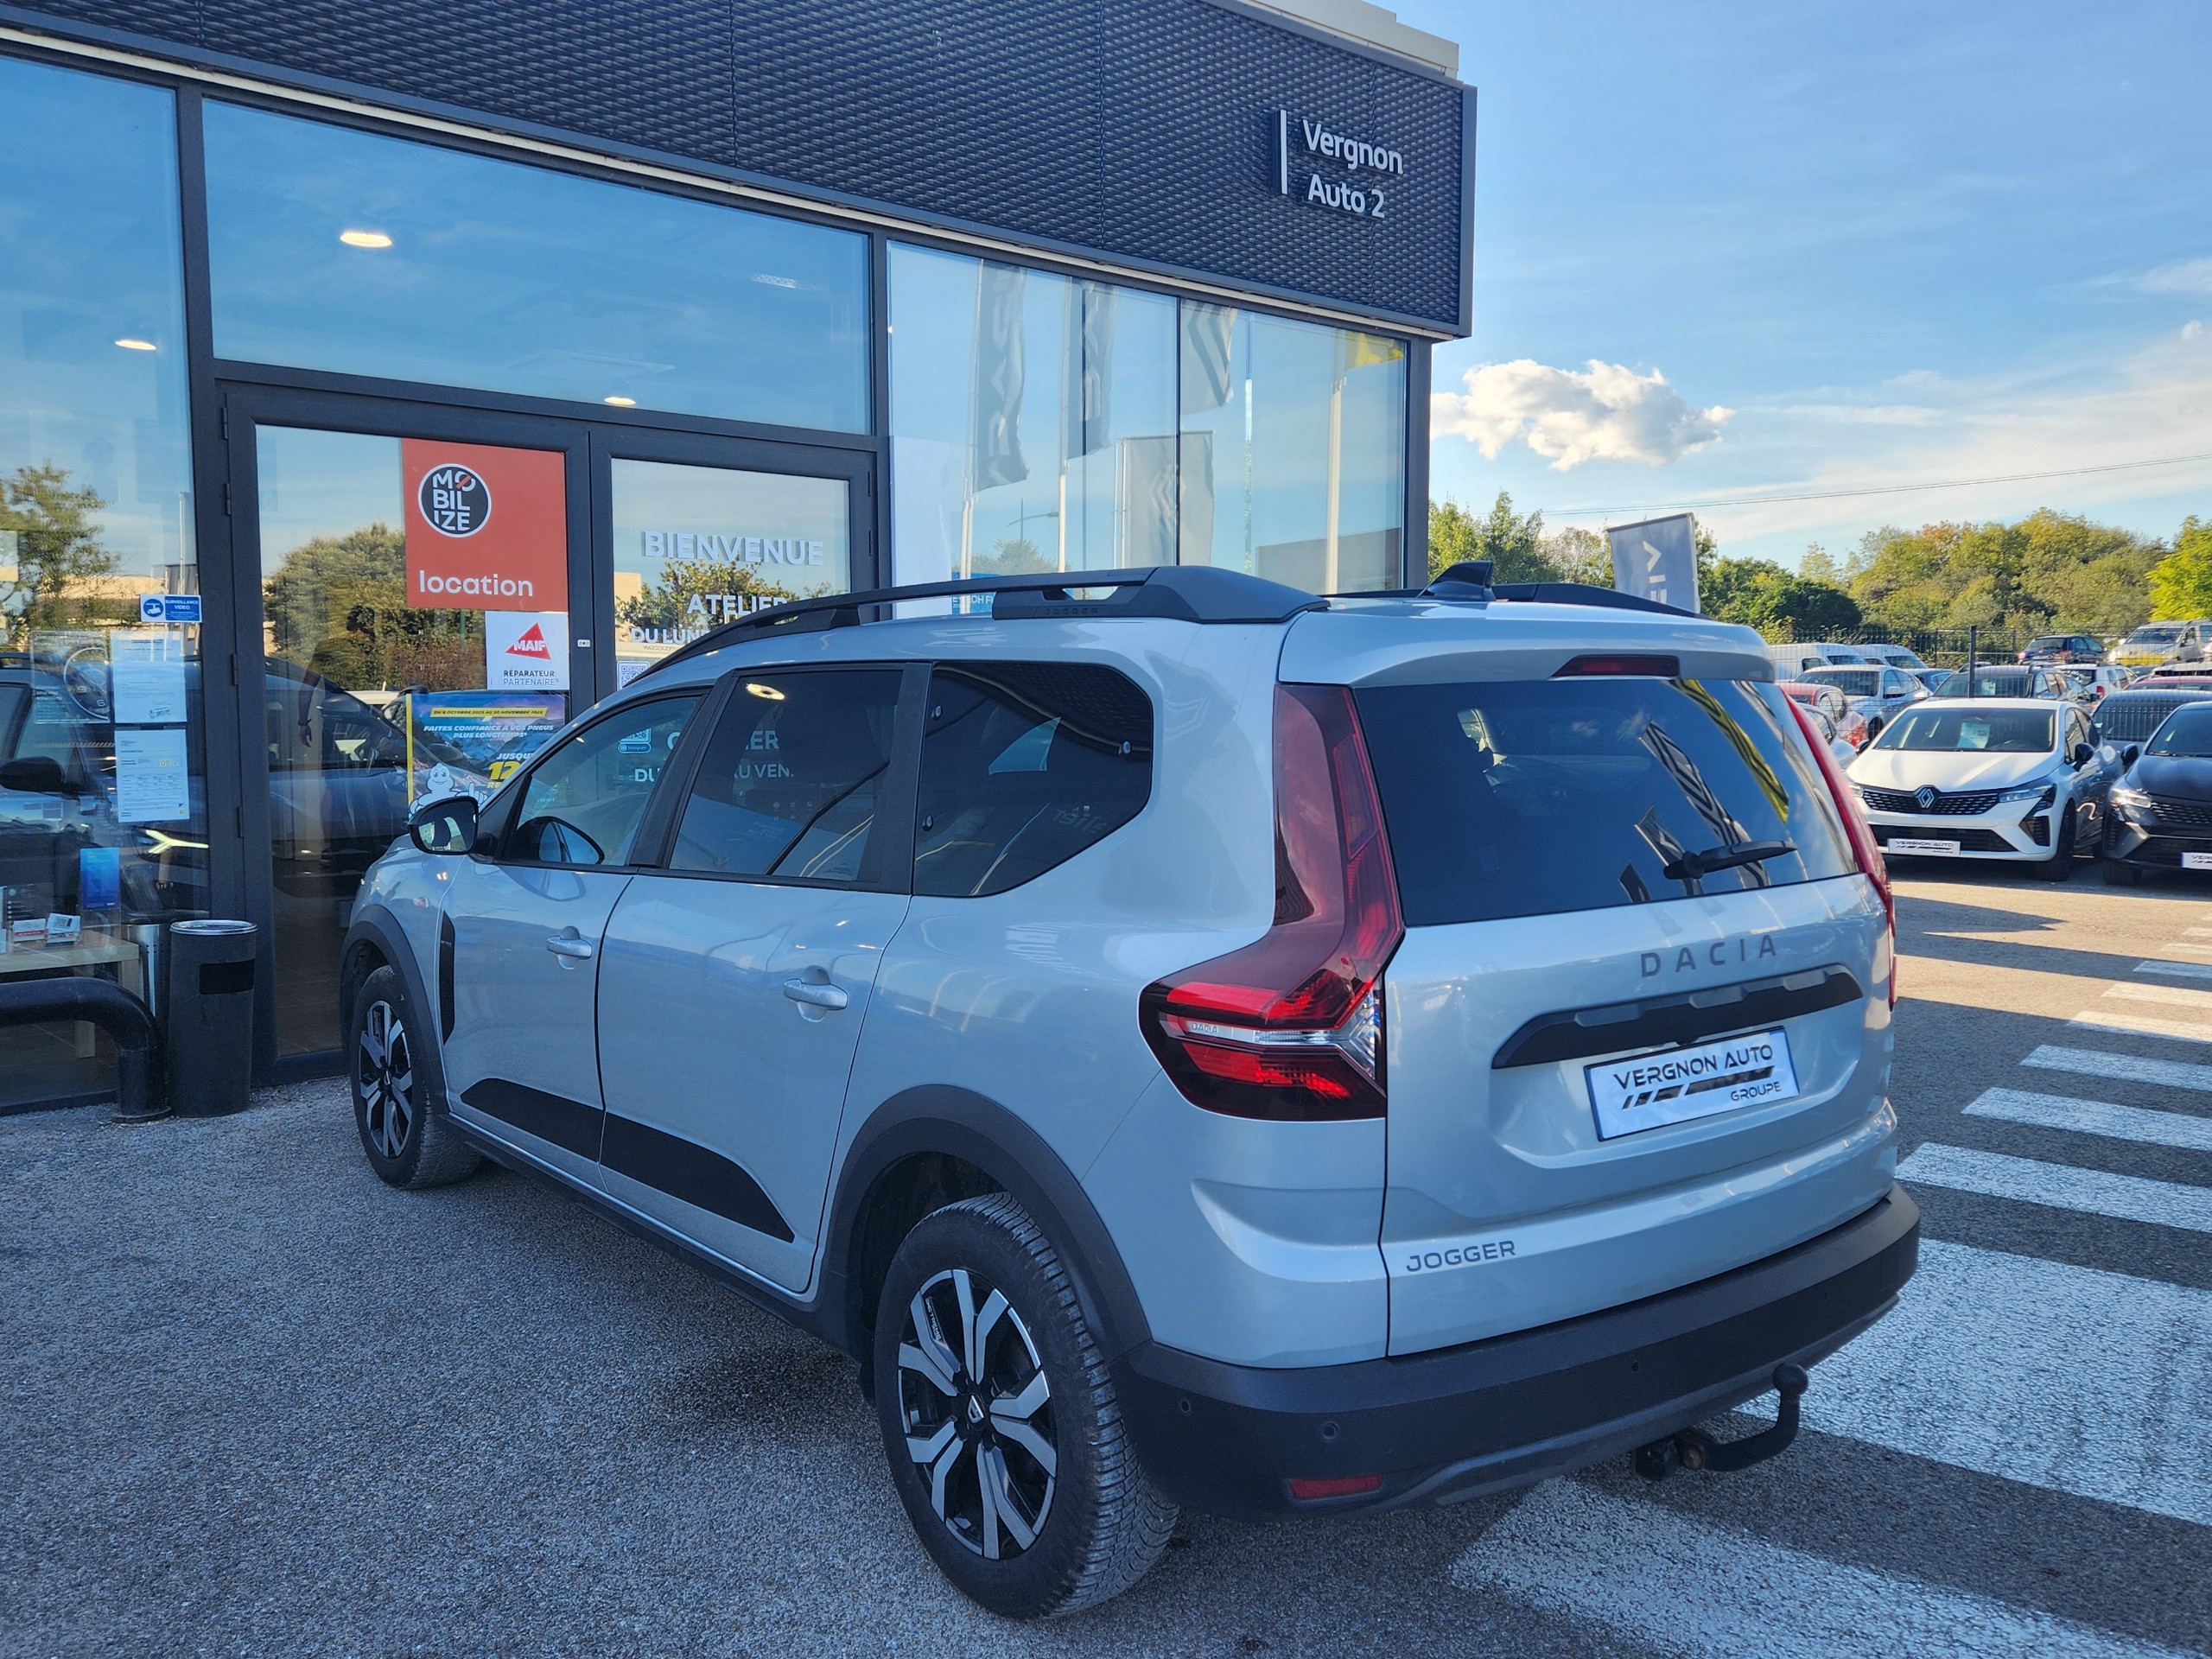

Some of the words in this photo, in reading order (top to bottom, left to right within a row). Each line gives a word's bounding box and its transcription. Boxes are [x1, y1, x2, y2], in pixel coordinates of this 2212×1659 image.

[1303, 119, 1403, 174] Vergnon
[1308, 174, 1366, 213] Auto
[1371, 189, 1385, 218] 2
[642, 531, 823, 566] BIENVENUE
[419, 570, 533, 596] location
[513, 639, 546, 652] MAIF
[631, 628, 658, 644] DU
[662, 629, 710, 645] LUN
[504, 668, 555, 677] RÉPARATEUR
[1641, 934, 1777, 978] DACIA
[1192, 1022, 1217, 1033] DACIA
[1613, 1054, 1718, 1090] VERGNON
[1724, 1044, 1773, 1070] AUTO
[1730, 1081, 1782, 1103] GROUPE
[1406, 1240, 1516, 1273] JOGGER
